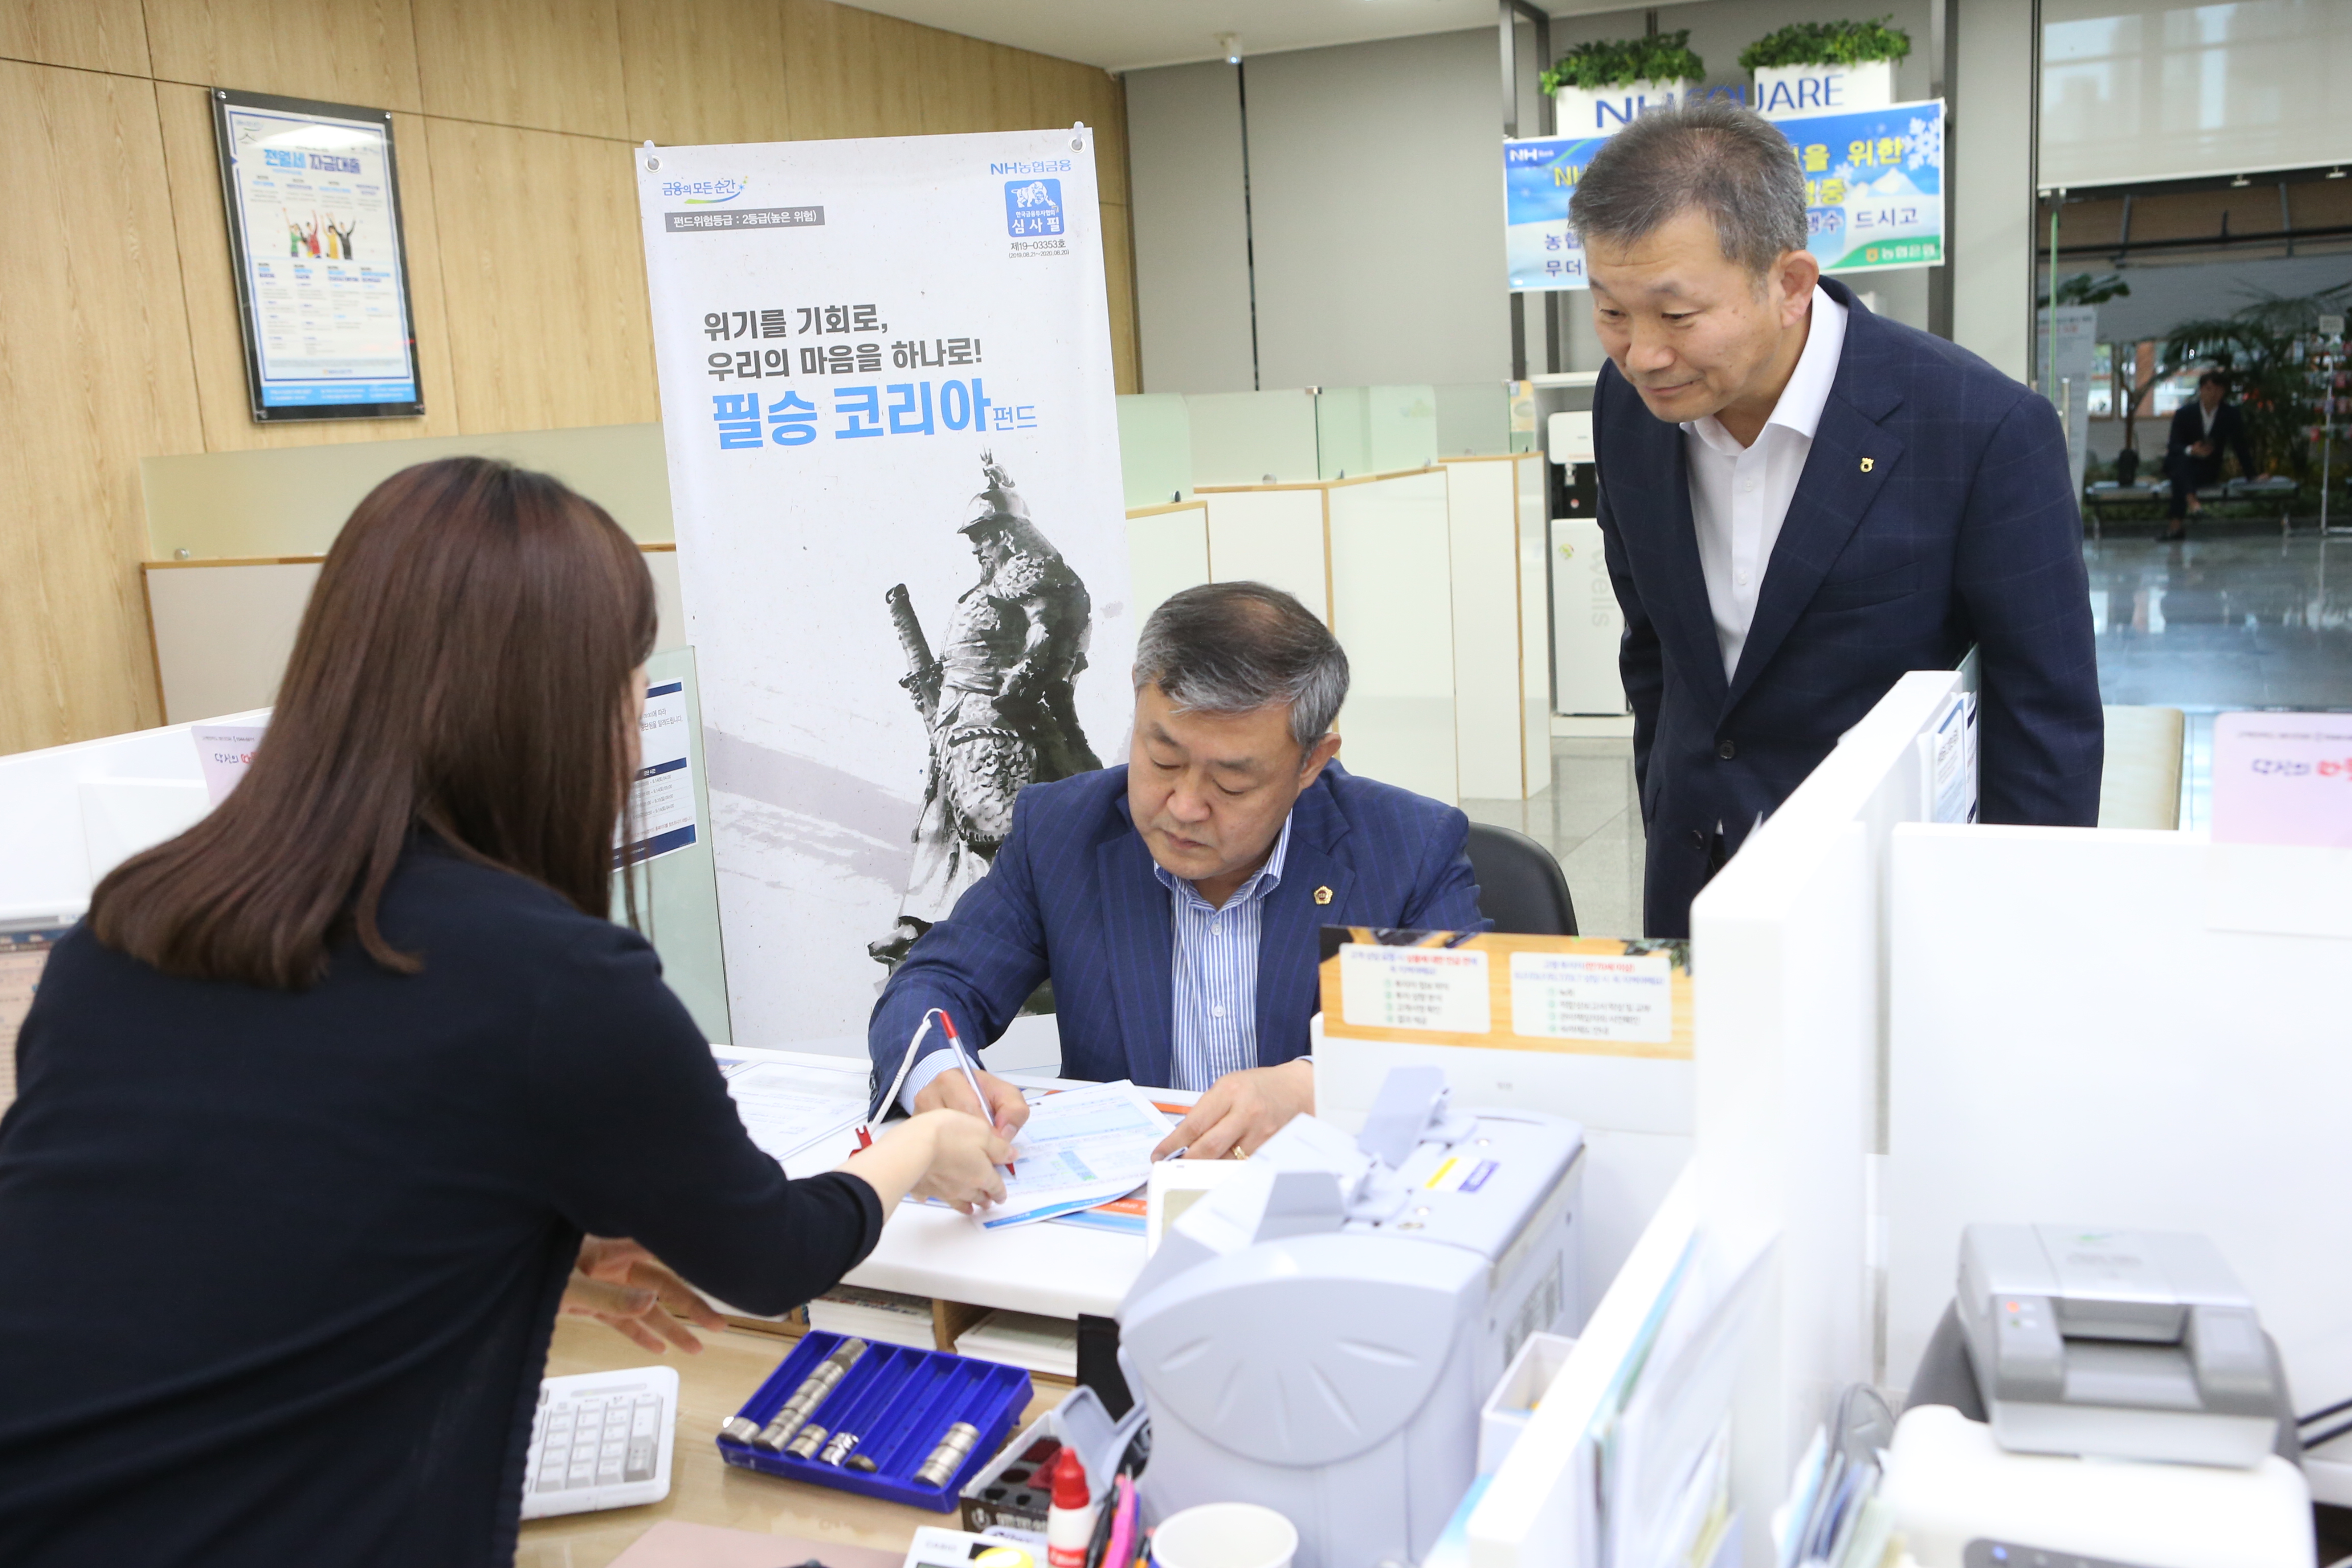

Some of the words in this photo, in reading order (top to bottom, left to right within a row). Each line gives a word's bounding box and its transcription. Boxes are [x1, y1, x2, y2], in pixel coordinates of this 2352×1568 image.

[263, 149, 306, 169] 전월세
[309, 154, 361, 174] 자금대출
[1509, 148, 1538, 162] NH
[1794, 143, 1830, 173] 을
[1848, 136, 1904, 167] 위한
[990, 159, 1071, 175] NH농협금융
[662, 182, 692, 195] 금융의
[693, 182, 713, 194] 모든
[714, 179, 736, 193] 순간
[673, 215, 733, 228] 펀드위험등급
[742, 211, 790, 225] 2등급(높은
[794, 209, 817, 223] 위험)
[1016, 209, 1056, 217] 한국금융투자협회
[1545, 232, 1582, 251] 농협
[1855, 207, 1919, 229] 드시고
[1545, 259, 1581, 277] 무더
[704, 310, 787, 341] 위기를
[796, 304, 888, 336] 기회로,
[707, 348, 789, 381] 우리의
[800, 343, 883, 375] 마음을
[892, 338, 982, 370] 하나로!
[713, 389, 817, 450] 필승
[835, 378, 991, 440] 코리아
[992, 405, 1038, 431] 펀드
[657, 715, 683, 727] 알려드립니다.
[215, 753, 238, 764] 당신의
